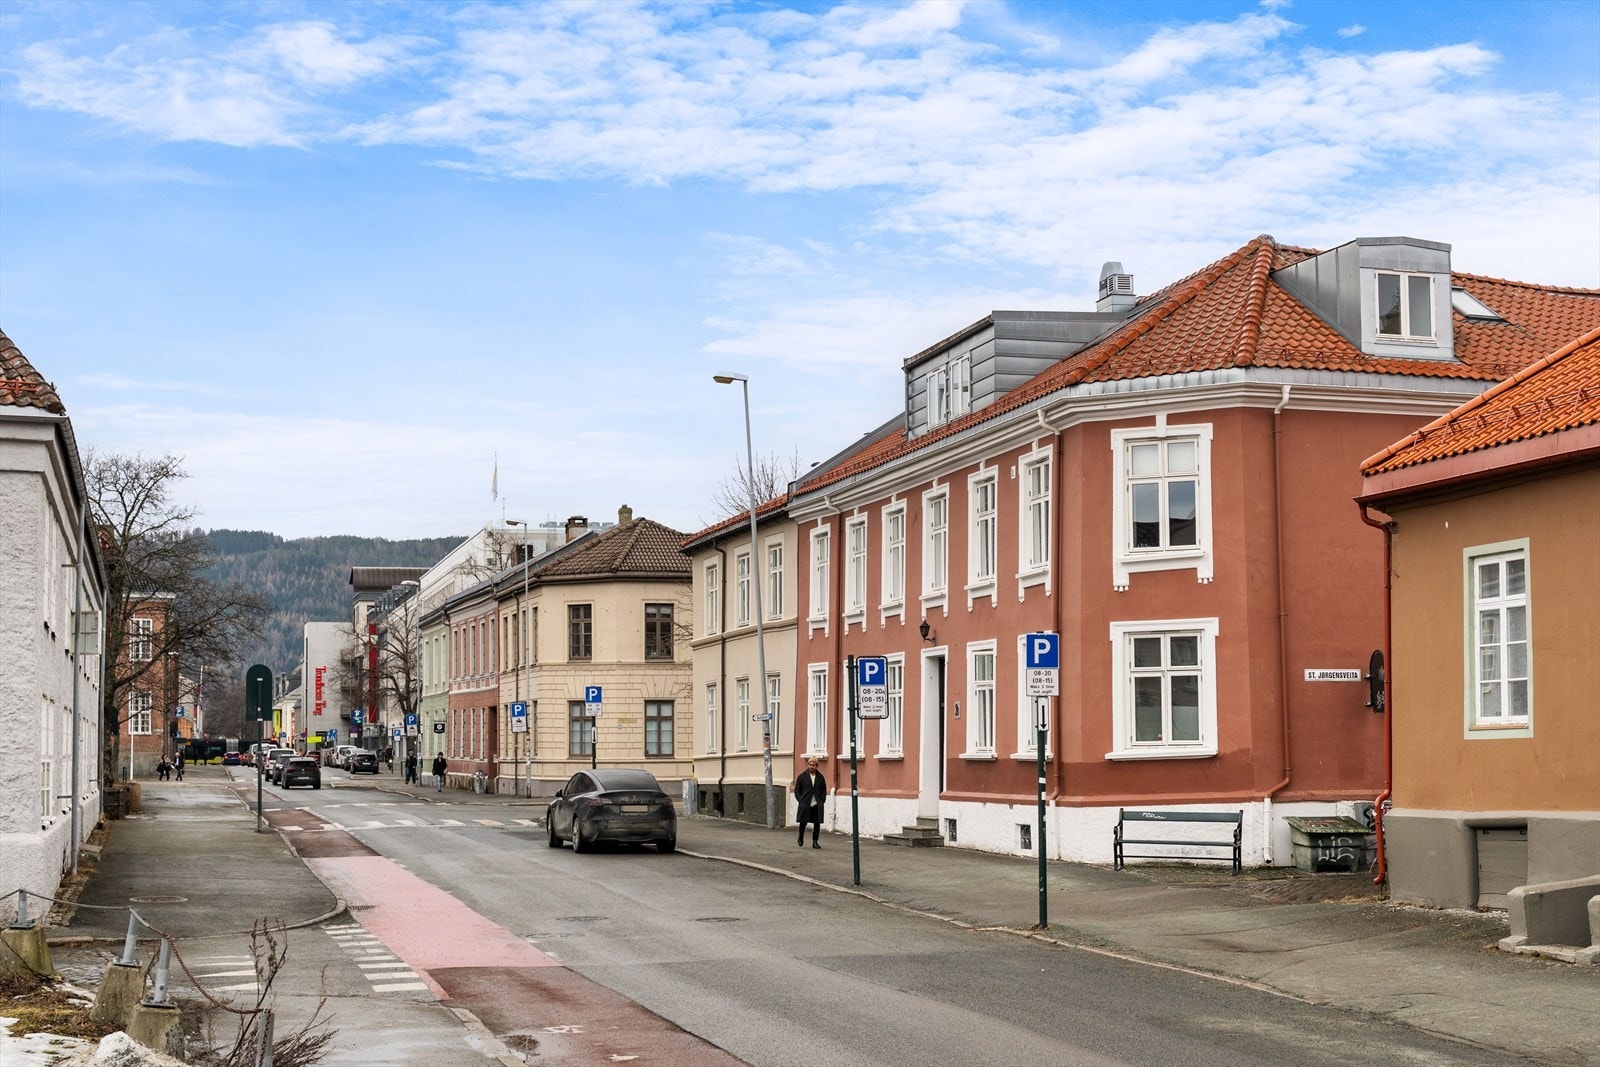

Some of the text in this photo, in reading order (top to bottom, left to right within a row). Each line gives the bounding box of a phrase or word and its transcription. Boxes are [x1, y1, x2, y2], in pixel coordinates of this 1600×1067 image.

[1034, 638, 1051, 664] P
[865, 662, 879, 682] P
[589, 688, 598, 701] P
[312, 701, 327, 716] Torg
[514, 705, 522, 716] P
[408, 715, 415, 724] P
